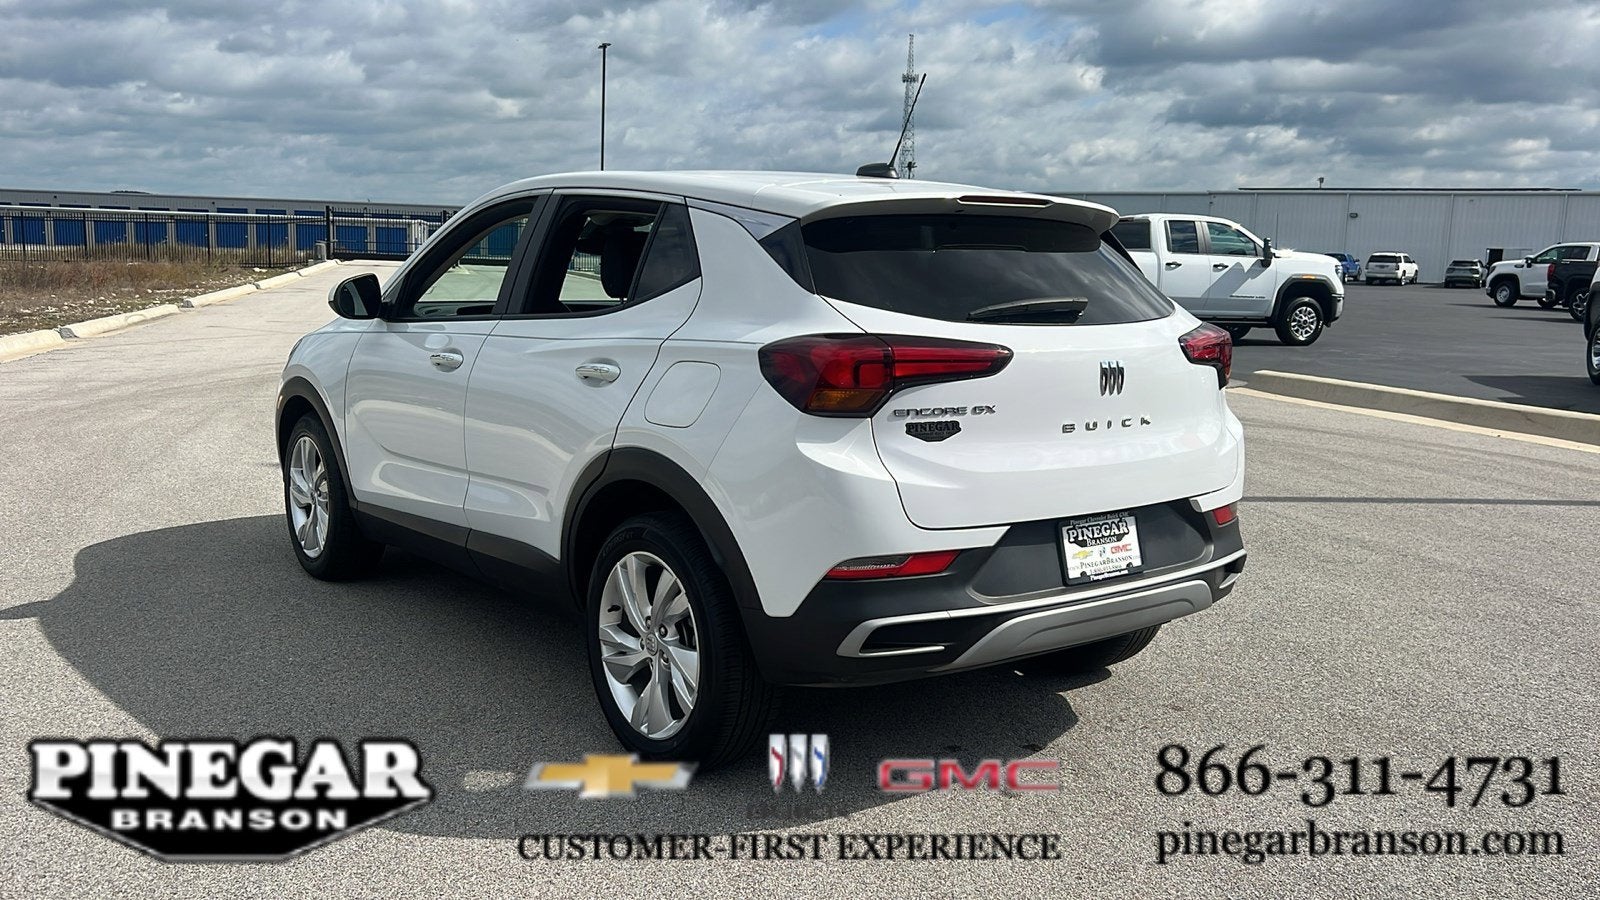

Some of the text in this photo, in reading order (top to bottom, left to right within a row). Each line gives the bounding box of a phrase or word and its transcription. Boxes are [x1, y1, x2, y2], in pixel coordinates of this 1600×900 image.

[892, 405, 996, 417] ENCORE GX
[907, 422, 960, 433] PINEGAR
[1062, 413, 1151, 433] BUICK
[1068, 521, 1129, 542] PINEGAR
[1086, 536, 1117, 547] BRANSON
[1110, 544, 1132, 554] GMC
